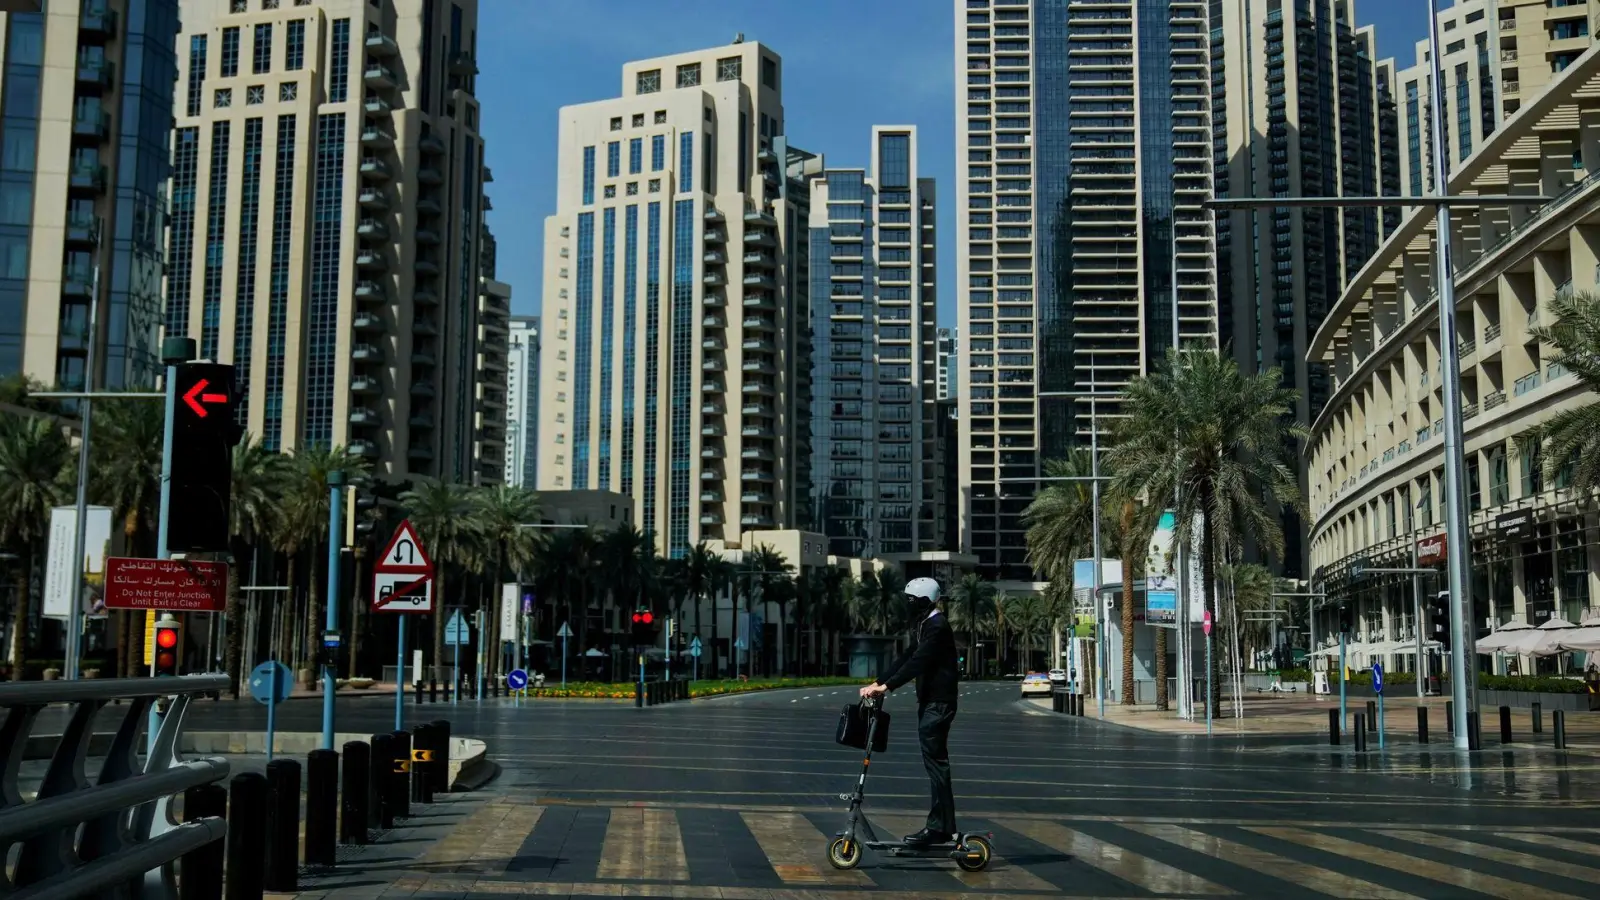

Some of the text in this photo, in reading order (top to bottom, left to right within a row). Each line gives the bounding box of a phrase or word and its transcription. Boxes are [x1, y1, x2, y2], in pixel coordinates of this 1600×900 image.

[122, 588, 211, 599] Do Not Enter Junction
[131, 598, 201, 608] Until Exit is Clear
